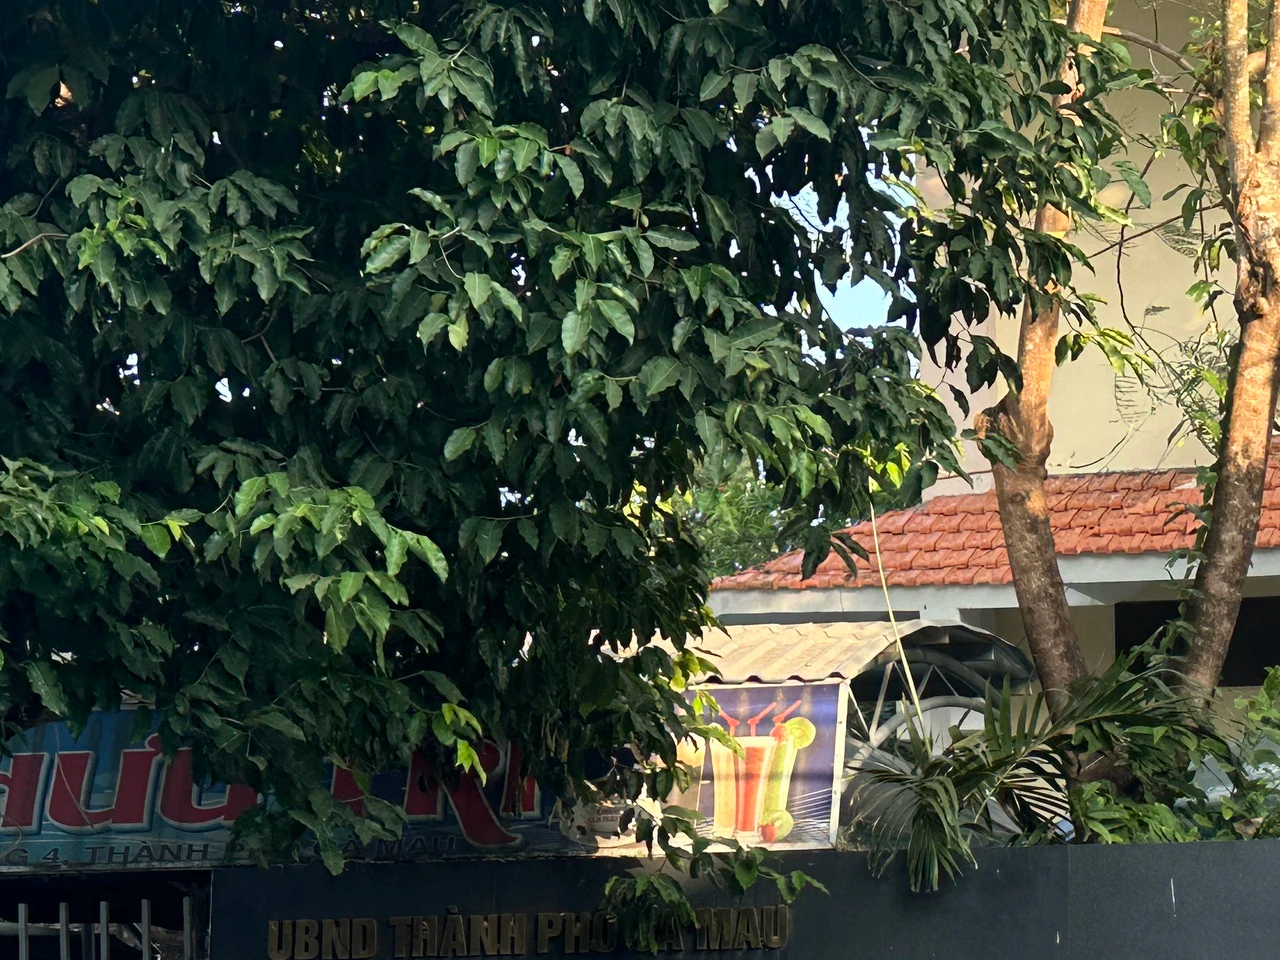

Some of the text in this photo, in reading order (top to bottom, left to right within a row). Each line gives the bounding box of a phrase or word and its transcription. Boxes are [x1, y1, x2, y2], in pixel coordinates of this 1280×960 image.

[84, 840, 209, 864] THÀNH
[388, 904, 526, 959] THÀNH
[695, 904, 789, 951] MAU
